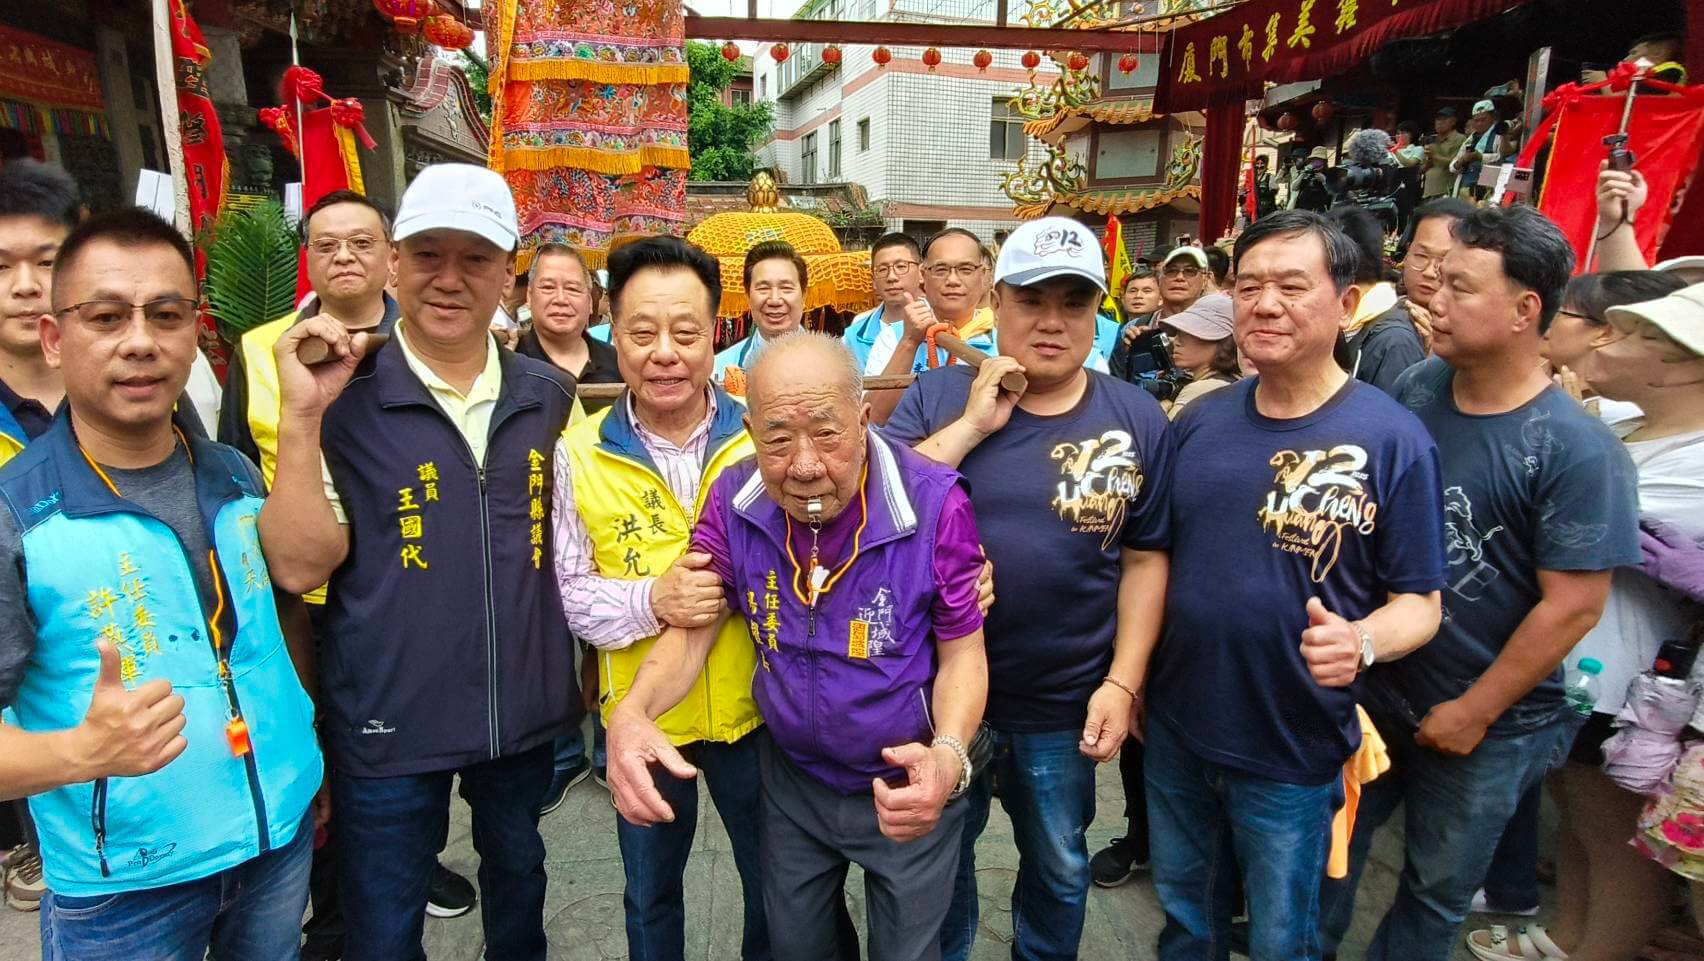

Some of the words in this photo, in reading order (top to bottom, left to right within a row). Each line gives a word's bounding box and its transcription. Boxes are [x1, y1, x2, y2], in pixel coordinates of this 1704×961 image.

[416, 461, 439, 502] 議員
[527, 448, 545, 570] 金門縣議會
[641, 487, 668, 536] 議長
[397, 486, 429, 570] 王國代
[612, 513, 652, 578] 洪允
[118, 551, 163, 656] 主任委員
[763, 569, 781, 653] 主任委員
